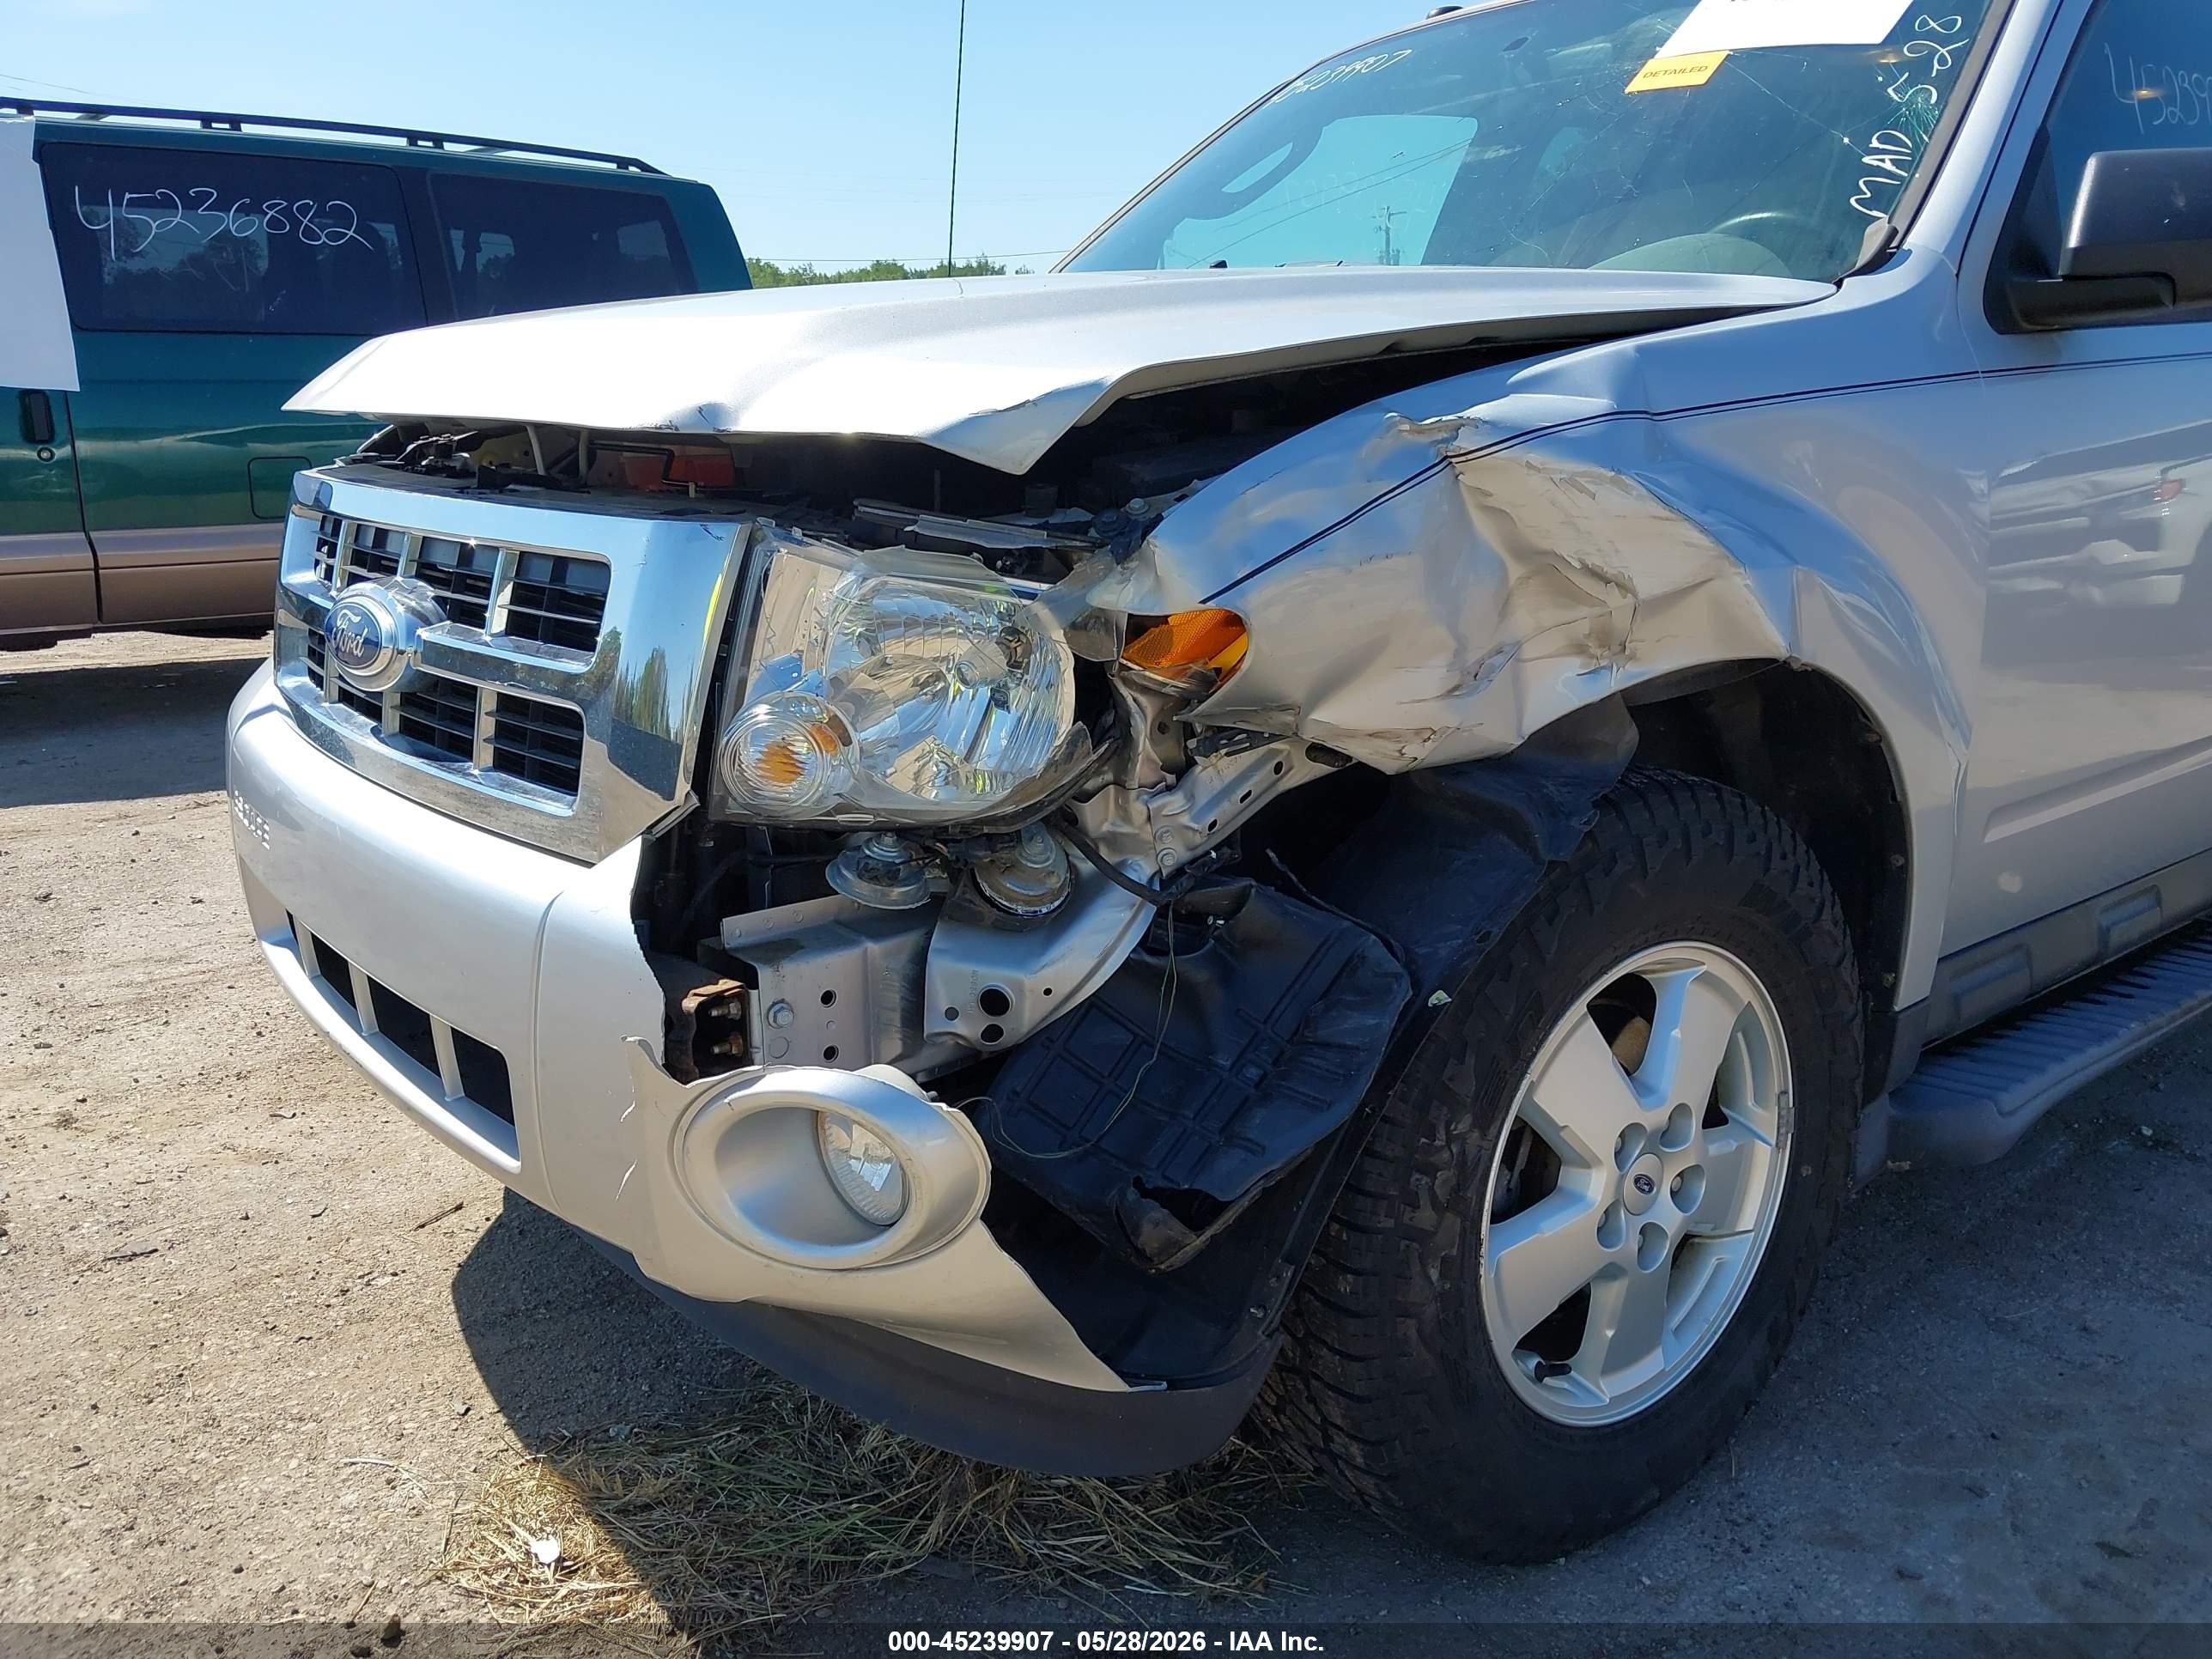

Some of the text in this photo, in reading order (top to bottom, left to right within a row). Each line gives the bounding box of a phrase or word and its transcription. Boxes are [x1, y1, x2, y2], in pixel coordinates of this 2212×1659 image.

[1642, 65, 1709, 79] DETAILED
[1850, 130, 1913, 218] MAD
[75, 185, 375, 261] 45236882
[332, 609, 368, 658] Ford
